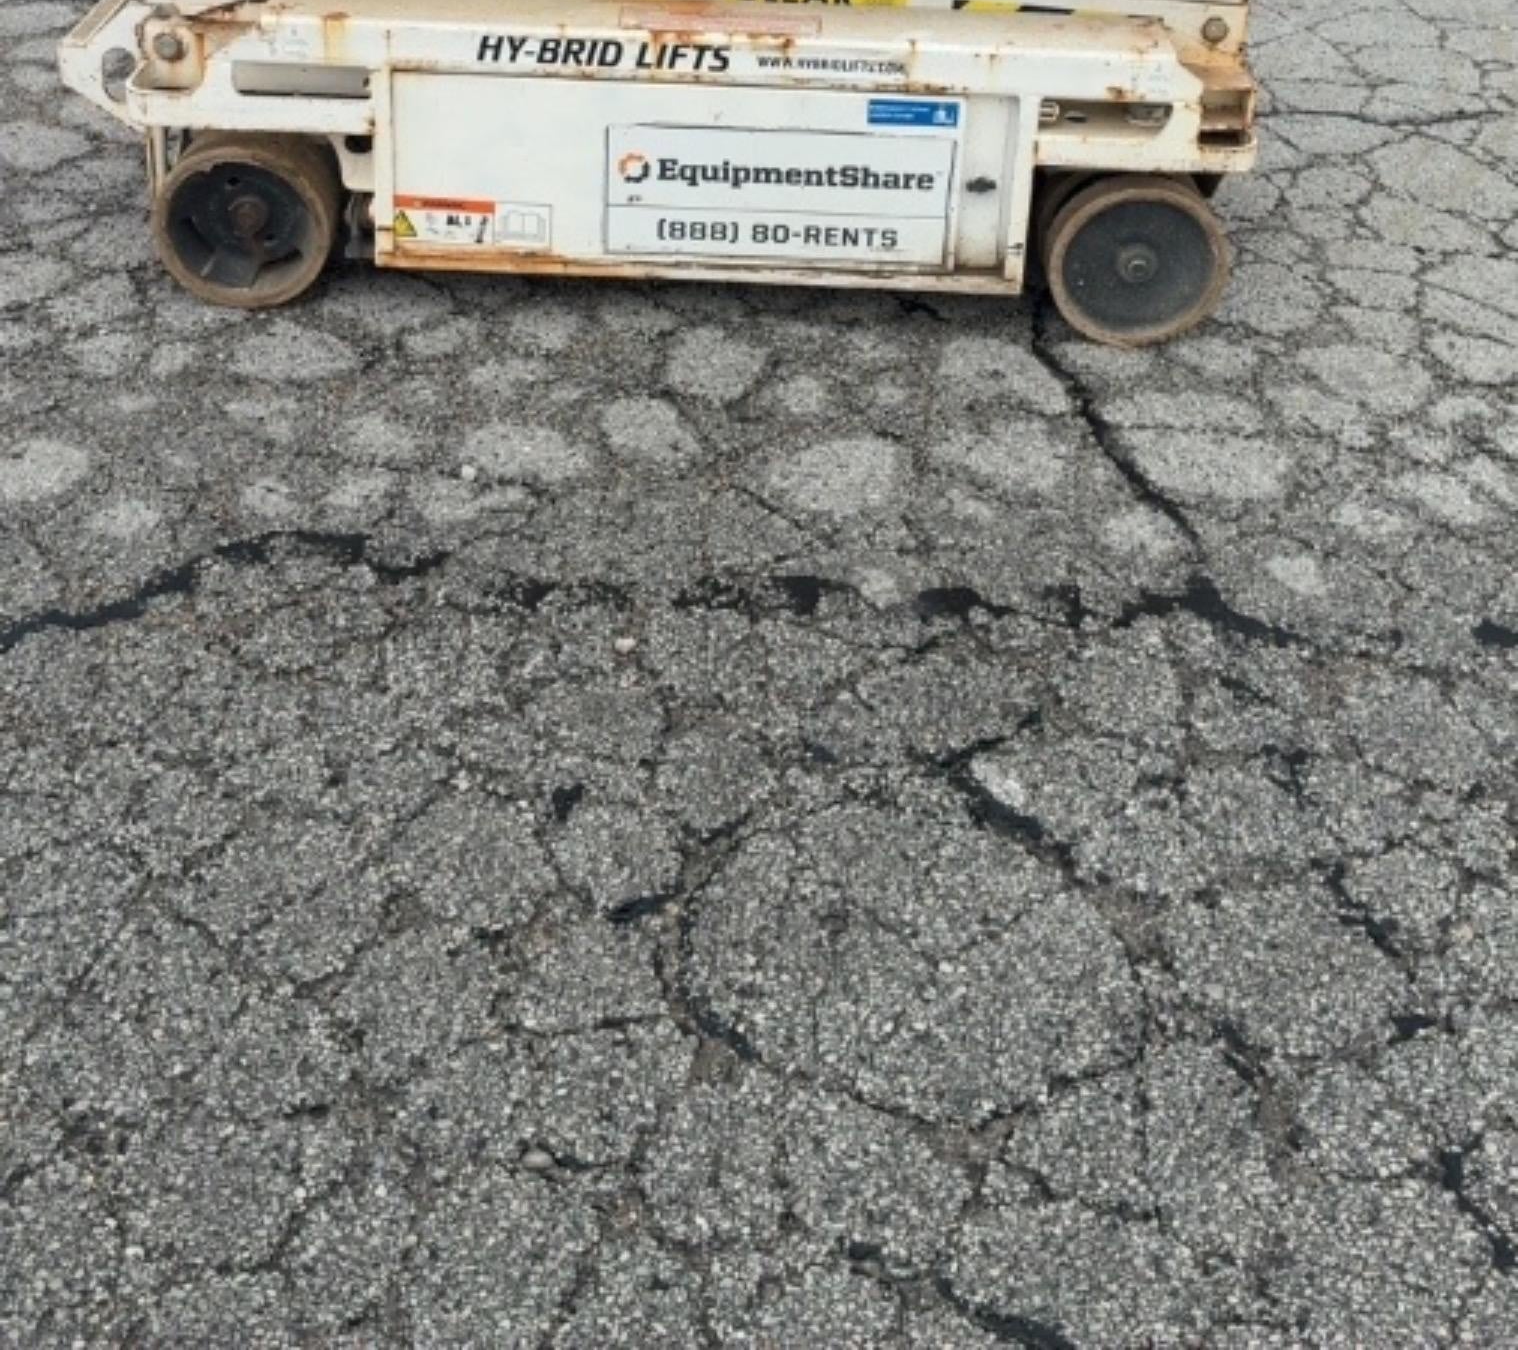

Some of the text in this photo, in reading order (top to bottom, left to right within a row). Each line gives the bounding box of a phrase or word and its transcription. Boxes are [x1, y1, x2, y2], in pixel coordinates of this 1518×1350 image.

[476, 34, 731, 73] HY-BRID LIFTS
[656, 157, 935, 191] EquipmentShare
[656, 217, 899, 249] (888) 80-RENTS
